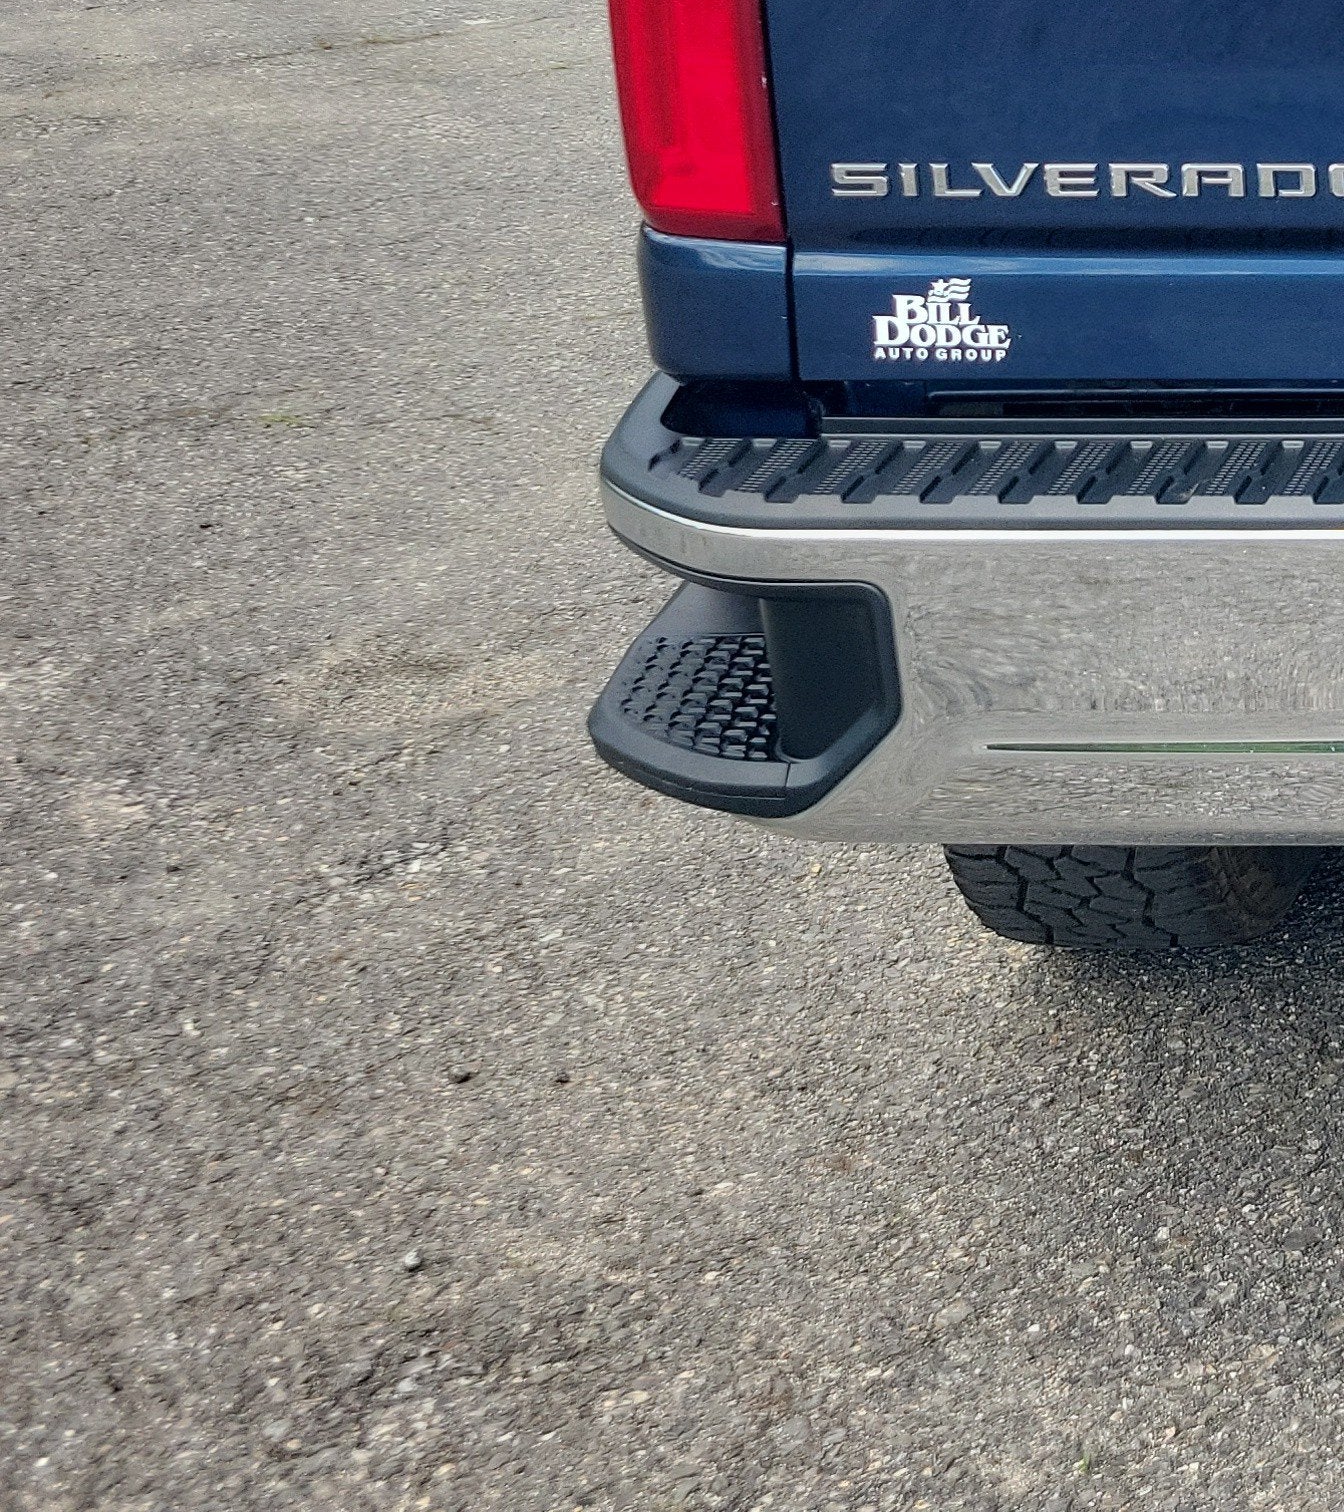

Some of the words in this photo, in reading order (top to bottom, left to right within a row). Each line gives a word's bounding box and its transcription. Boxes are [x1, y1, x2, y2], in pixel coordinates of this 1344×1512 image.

[892, 294, 980, 325] BILL
[872, 315, 1011, 348] DODGE
[874, 347, 928, 360] AUTO
[935, 348, 1006, 362] GROUP
